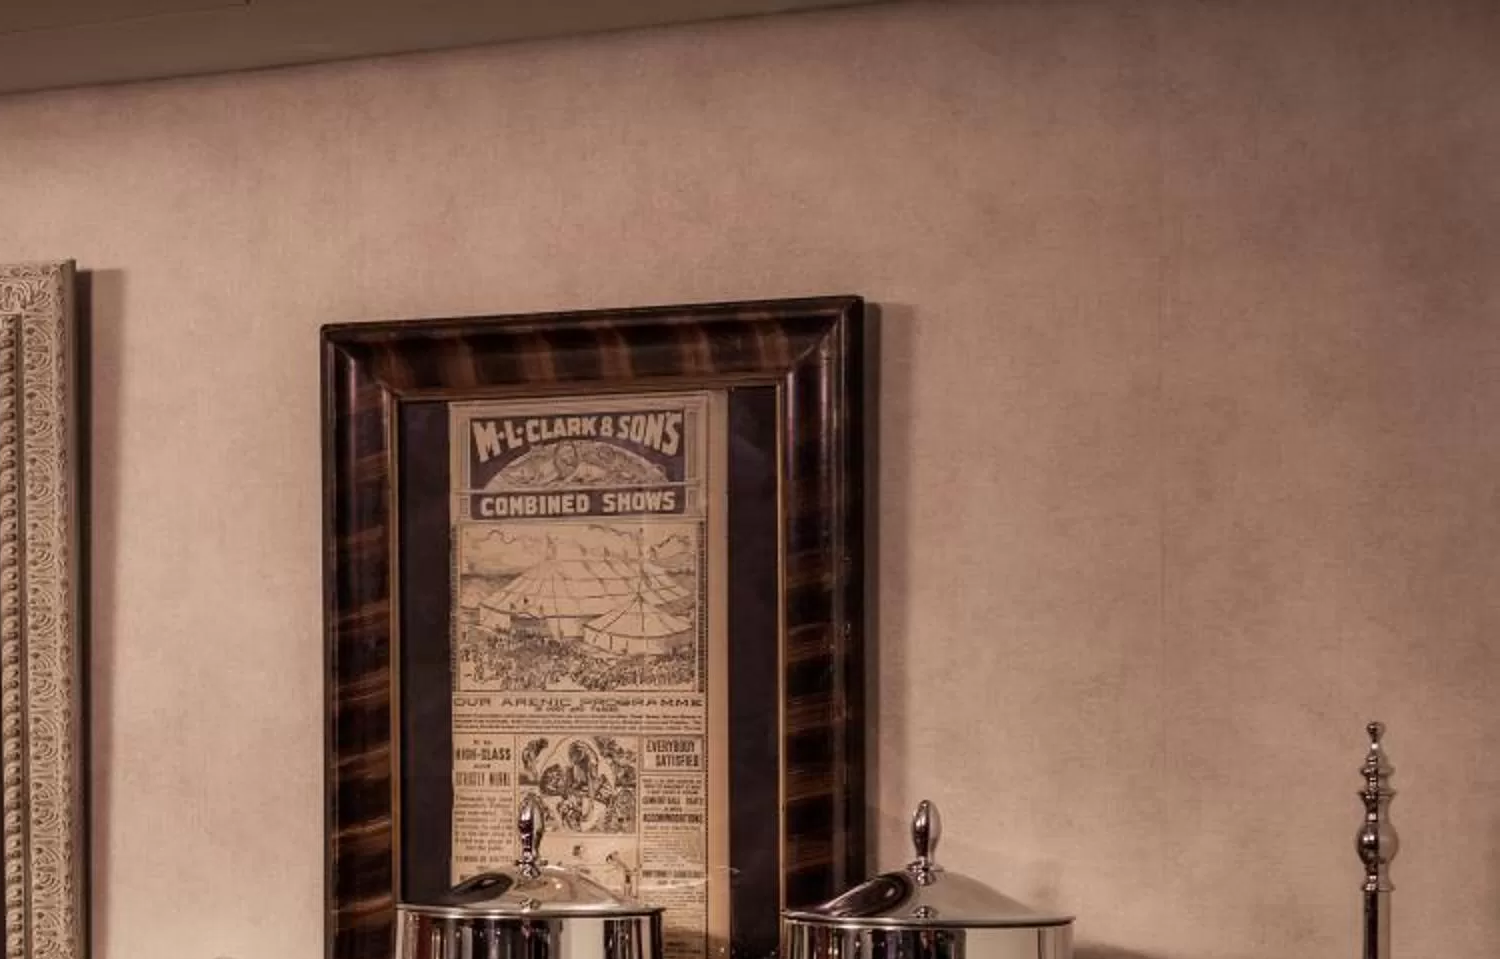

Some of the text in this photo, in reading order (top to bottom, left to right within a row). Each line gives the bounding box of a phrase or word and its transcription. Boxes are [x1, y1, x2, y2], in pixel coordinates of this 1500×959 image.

[525, 416, 598, 443] CLARK
[601, 415, 615, 437] &
[480, 490, 676, 516] COMBINED SHOWS
